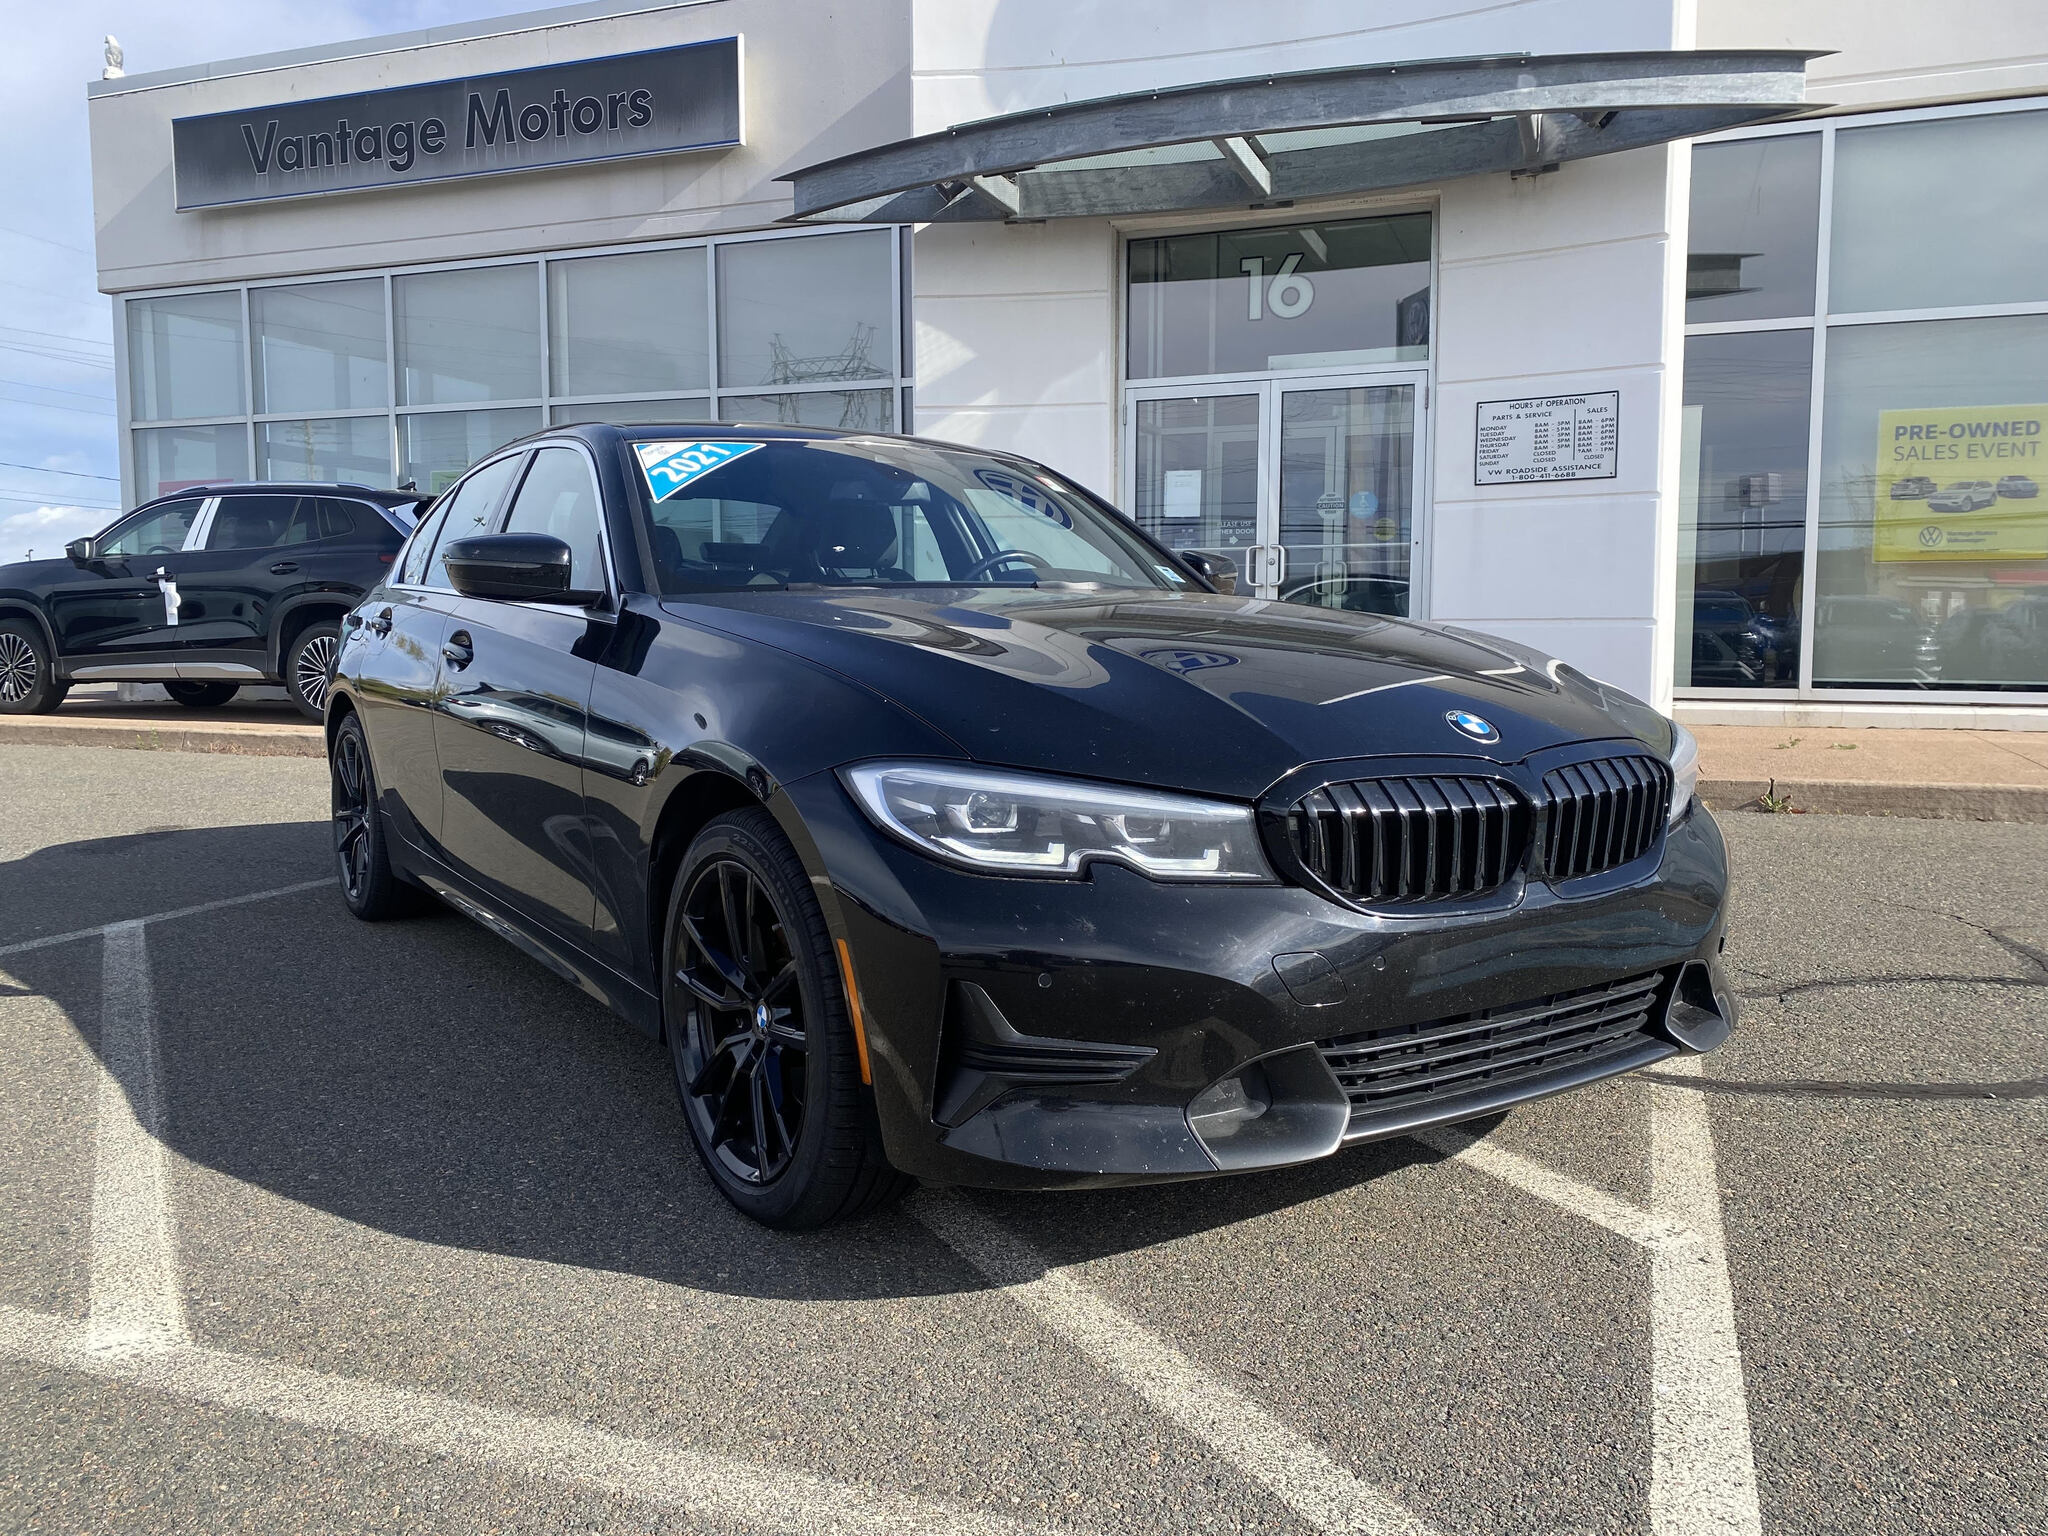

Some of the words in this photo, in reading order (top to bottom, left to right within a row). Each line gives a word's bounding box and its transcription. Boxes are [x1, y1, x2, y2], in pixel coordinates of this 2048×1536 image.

[240, 116, 447, 173] Vantage
[464, 88, 654, 150] Motors
[1240, 252, 1315, 320] 16
[1536, 400, 1543, 408] of
[1546, 398, 1586, 407] OPERATION
[1894, 420, 2041, 441] PRE-OWNED
[1893, 443, 1960, 462] SALES
[1967, 441, 2041, 459] EVENT
[651, 444, 731, 483] 2021
[1506, 466, 1548, 475] ROADSIDE
[1552, 463, 1602, 472] ASSISTANCE
[1512, 472, 1576, 480] 1-800-411-6688
